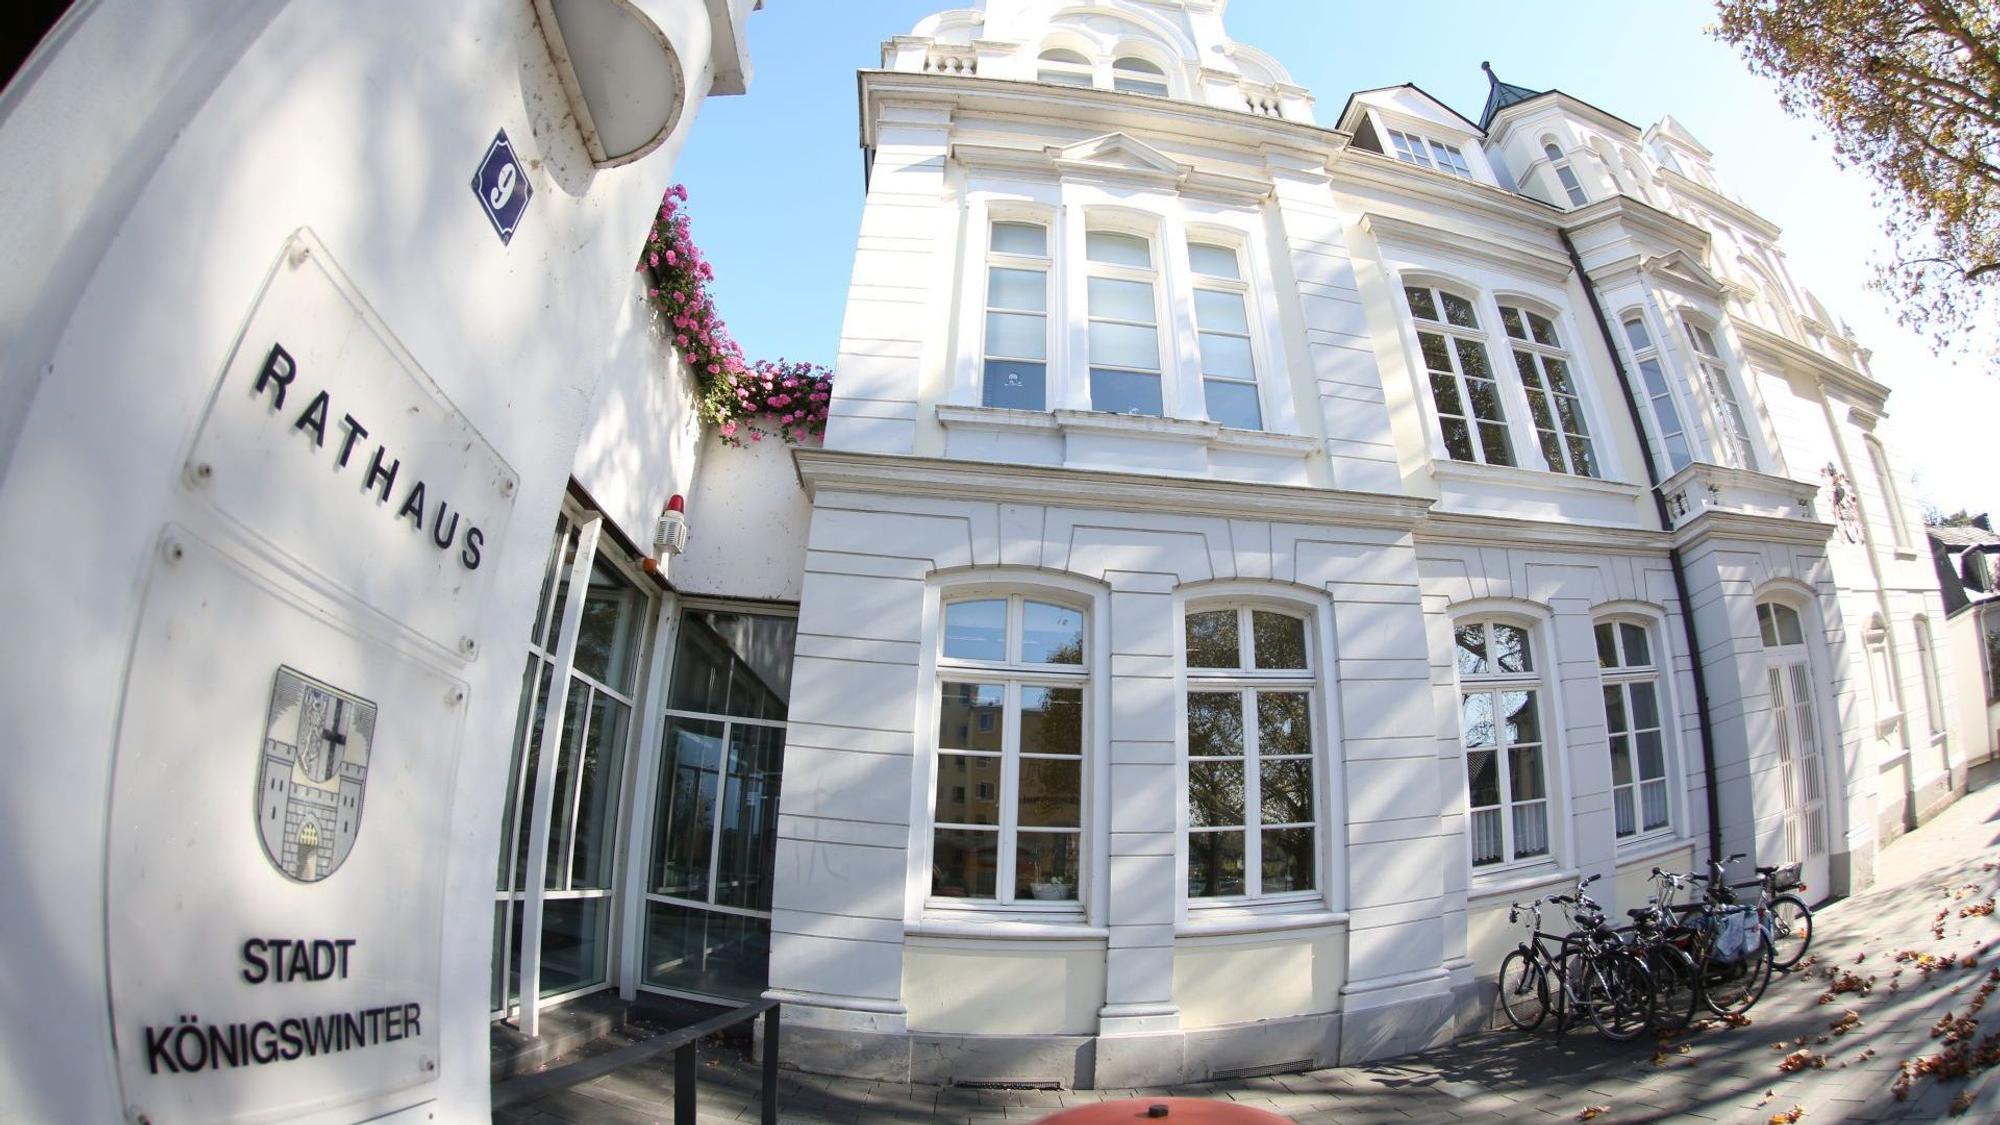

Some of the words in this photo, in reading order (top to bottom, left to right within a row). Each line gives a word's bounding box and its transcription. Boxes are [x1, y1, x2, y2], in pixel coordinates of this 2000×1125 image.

[490, 162, 517, 210] 9
[255, 341, 484, 571] RATHAUS
[242, 937, 357, 984] STADT
[145, 1002, 421, 1075] KÖNIGSWINTER
